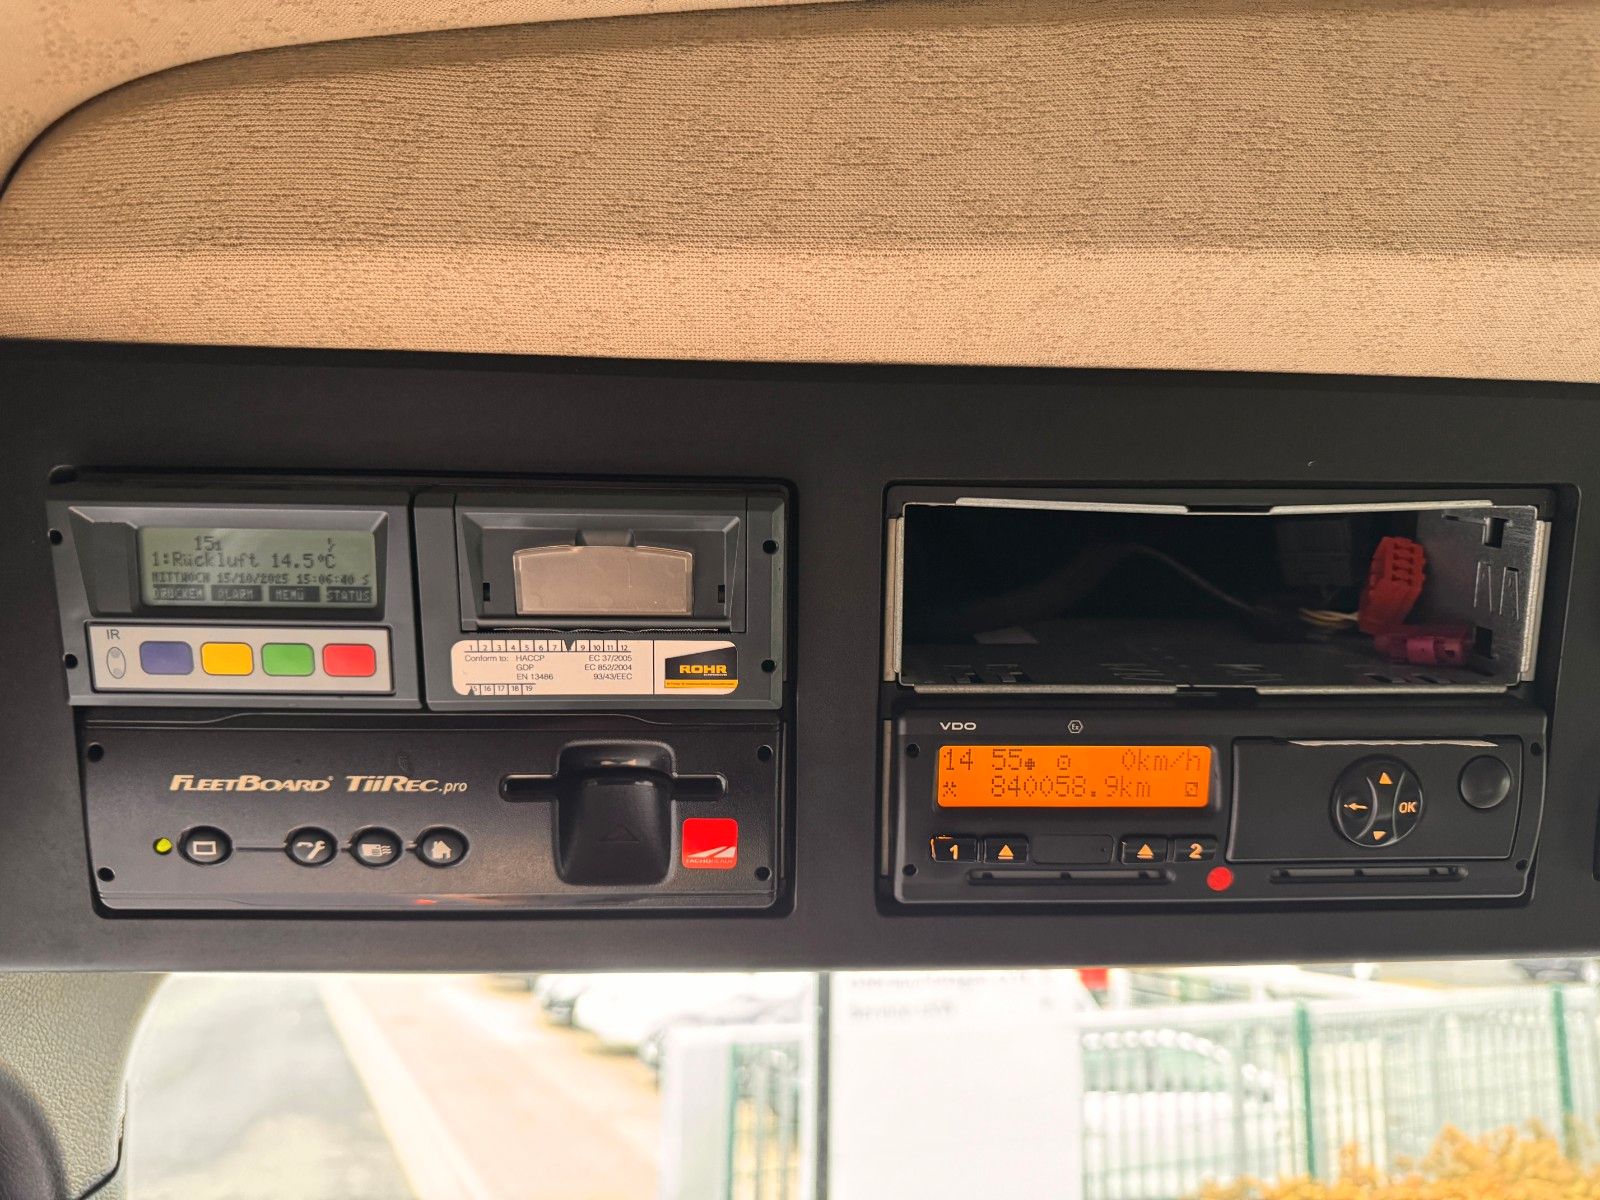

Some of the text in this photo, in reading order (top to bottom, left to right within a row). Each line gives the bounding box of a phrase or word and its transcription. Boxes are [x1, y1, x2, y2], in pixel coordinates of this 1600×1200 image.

[151, 571, 210, 584] MITTWOCH
[216, 573, 288, 585] 15/10/2025
[326, 588, 372, 601] STATUS
[106, 629, 121, 640] IR
[465, 654, 497, 662] Conform
[499, 654, 509, 662] to:
[604, 655, 633, 663] 37/2005
[516, 664, 534, 672] GDP
[598, 664, 632, 672] 852/2004
[679, 664, 727, 674] ROHR
[516, 673, 554, 681] EN 13486
[593, 673, 632, 681] 93/43/EEC
[939, 721, 977, 731] VDO
[1398, 801, 1417, 814] OK
[949, 843, 960, 860] 1
[1188, 843, 1204, 860] 2
